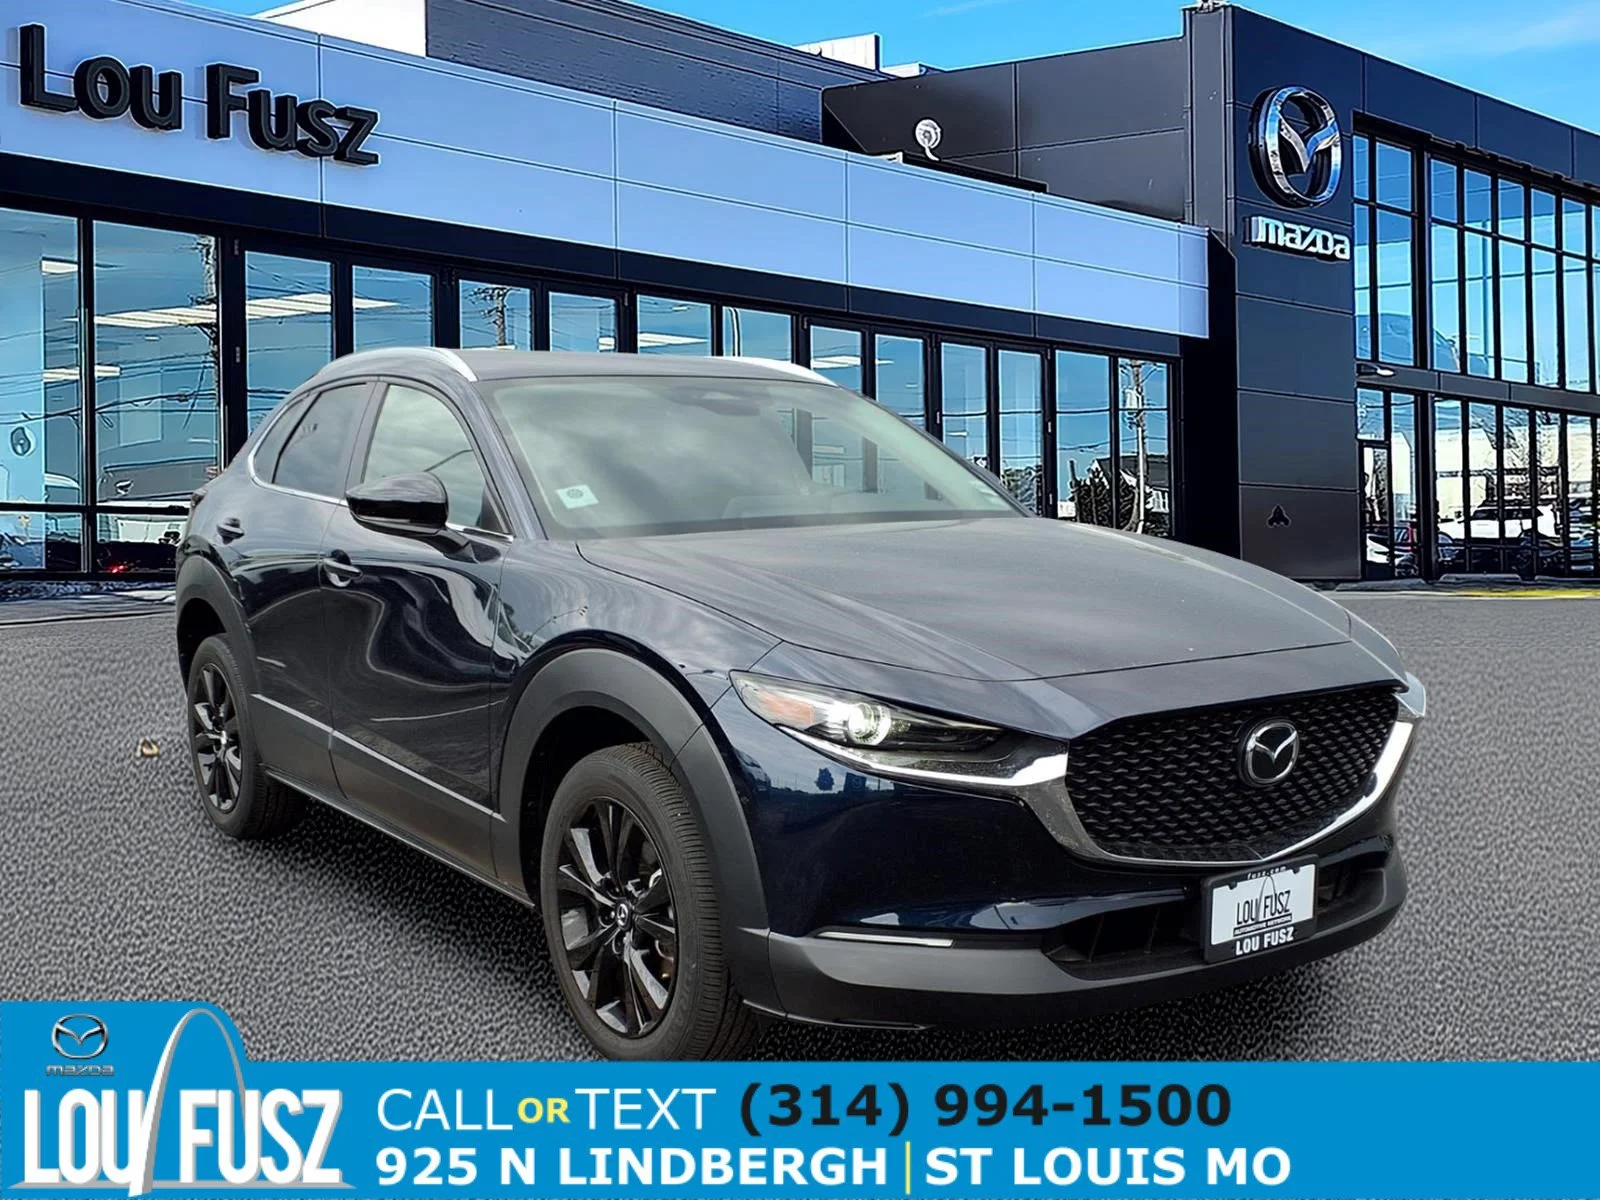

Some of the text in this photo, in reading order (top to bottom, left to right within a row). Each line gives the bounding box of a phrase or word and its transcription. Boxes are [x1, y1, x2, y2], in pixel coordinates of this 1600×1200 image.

[19, 23, 380, 166] Lou Fusz
[1236, 889, 1292, 925] LOU FUSZ
[1235, 926, 1294, 956] LOU FUSZ
